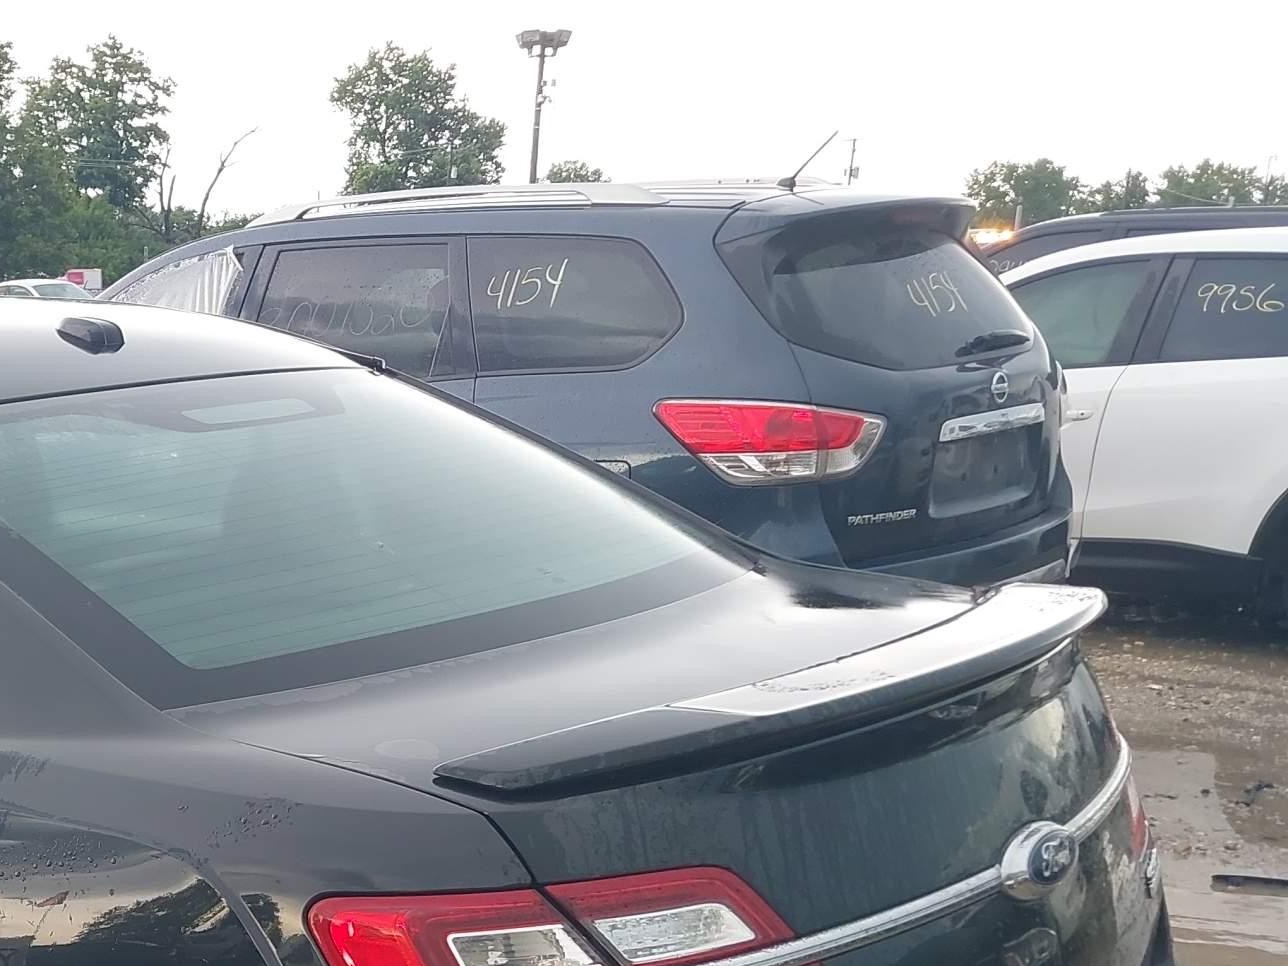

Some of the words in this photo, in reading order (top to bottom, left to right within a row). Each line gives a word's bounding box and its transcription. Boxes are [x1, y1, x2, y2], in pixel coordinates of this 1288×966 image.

[487, 258, 569, 310] 4154
[907, 271, 968, 317] 4154
[1198, 283, 1285, 314] 9956
[847, 508, 917, 526] PATHFINDER
